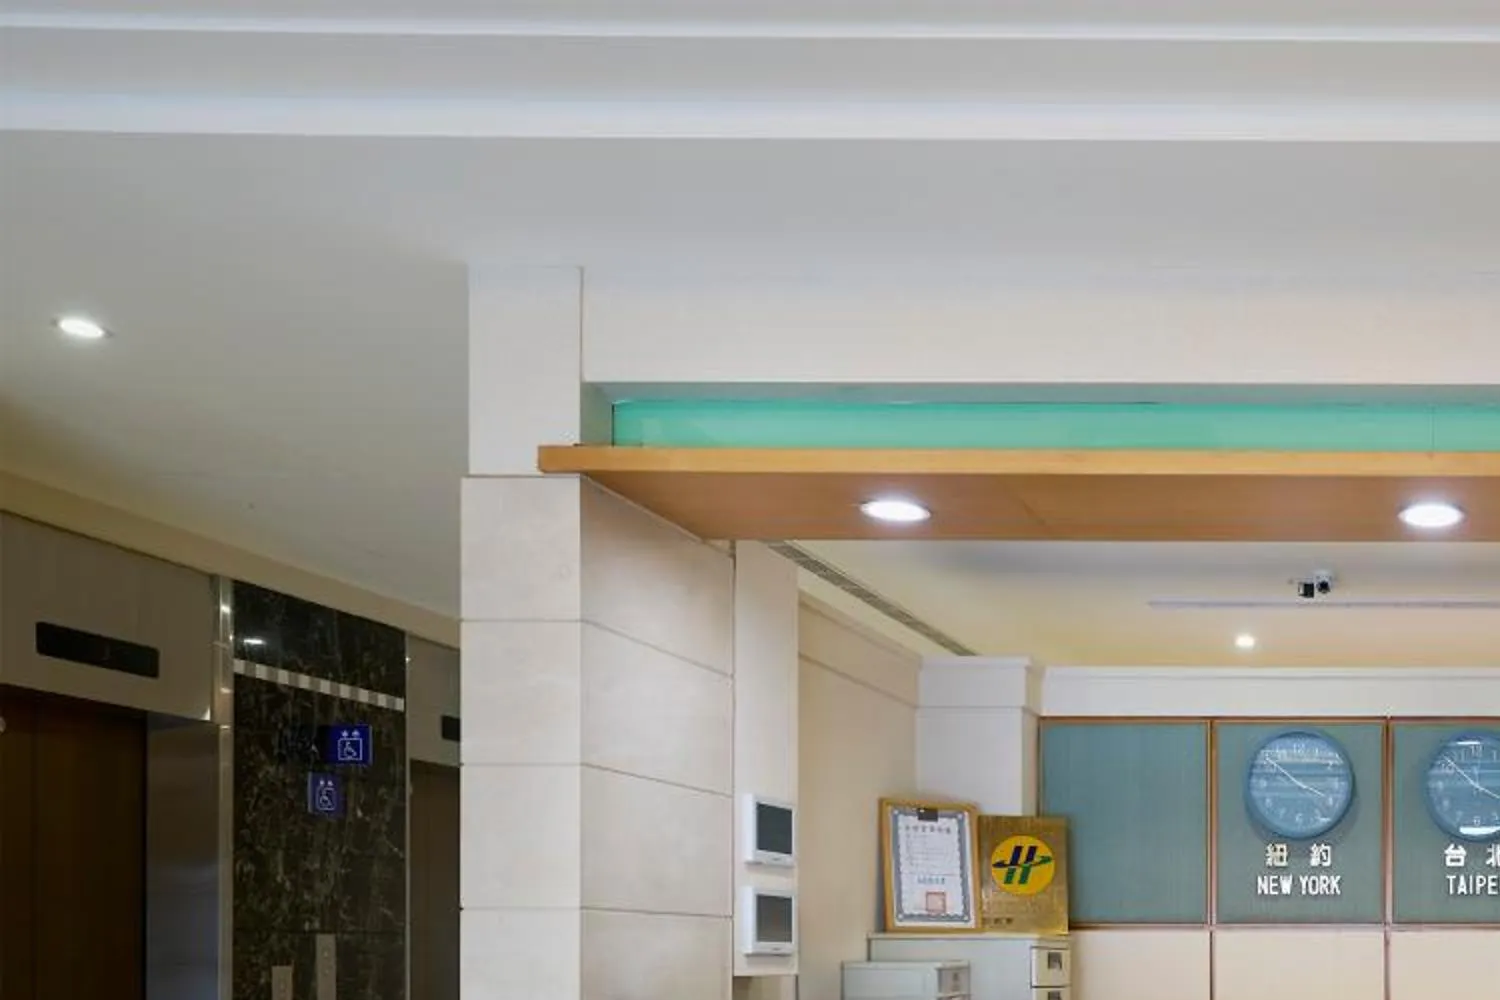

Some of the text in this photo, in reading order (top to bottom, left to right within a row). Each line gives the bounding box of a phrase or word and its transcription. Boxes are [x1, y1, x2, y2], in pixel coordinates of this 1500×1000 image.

[1265, 843, 1332, 867] 紐約
[1257, 874, 1342, 895] NEW YORK
